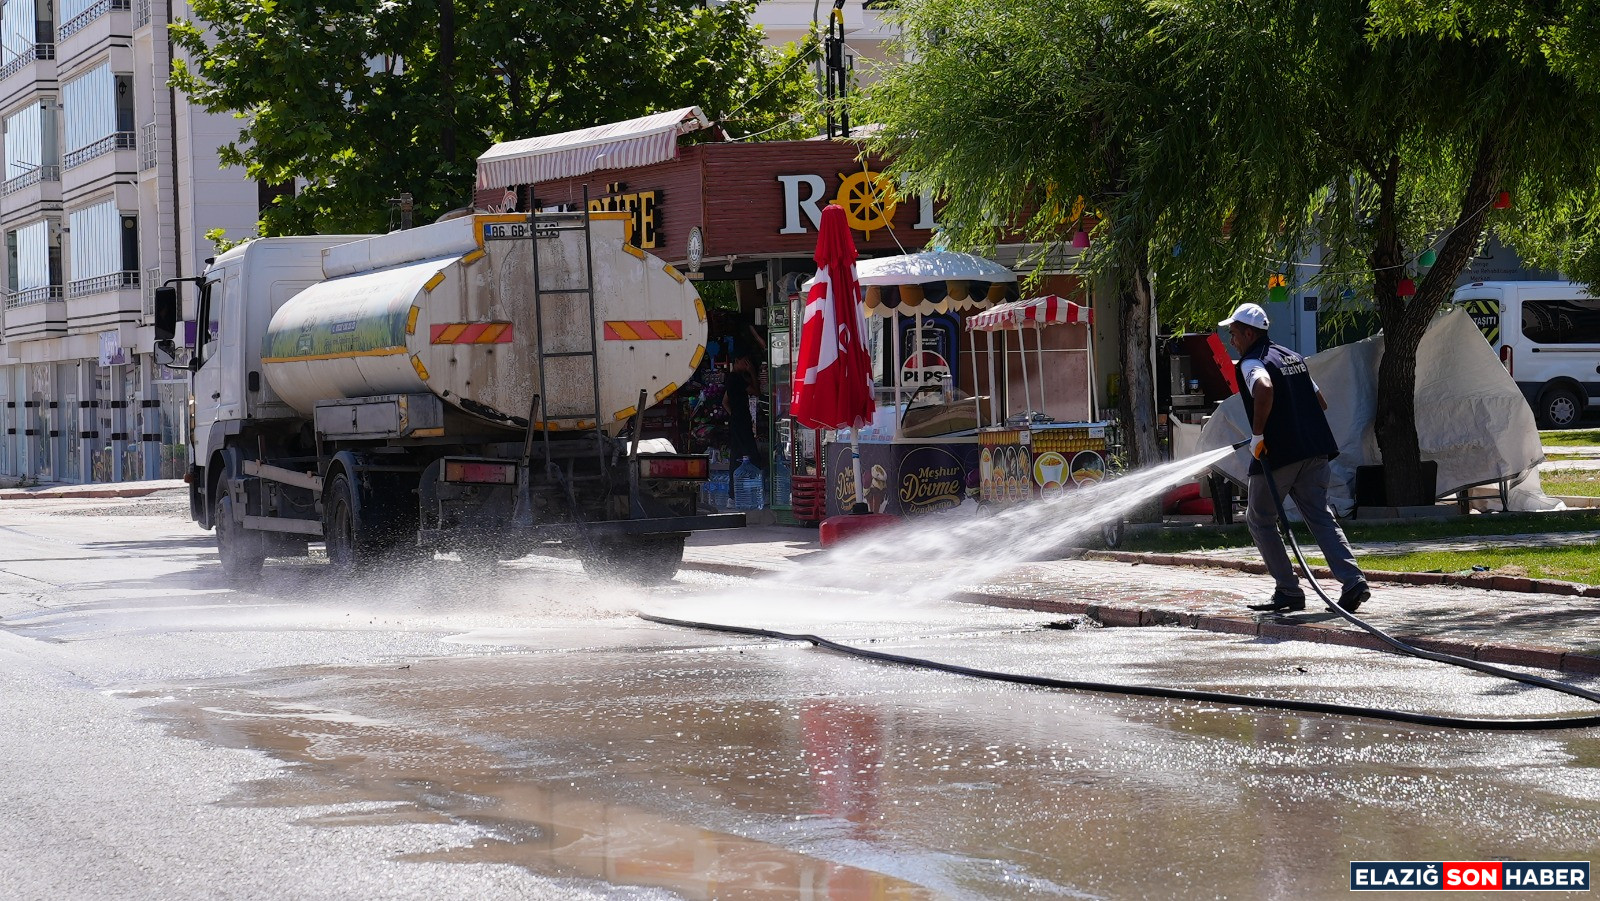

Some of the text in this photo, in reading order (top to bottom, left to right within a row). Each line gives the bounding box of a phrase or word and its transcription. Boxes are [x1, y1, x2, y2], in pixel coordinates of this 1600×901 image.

[511, 224, 524, 237] GB
[919, 466, 960, 480] Meşhur
[900, 474, 961, 502] Dövme
